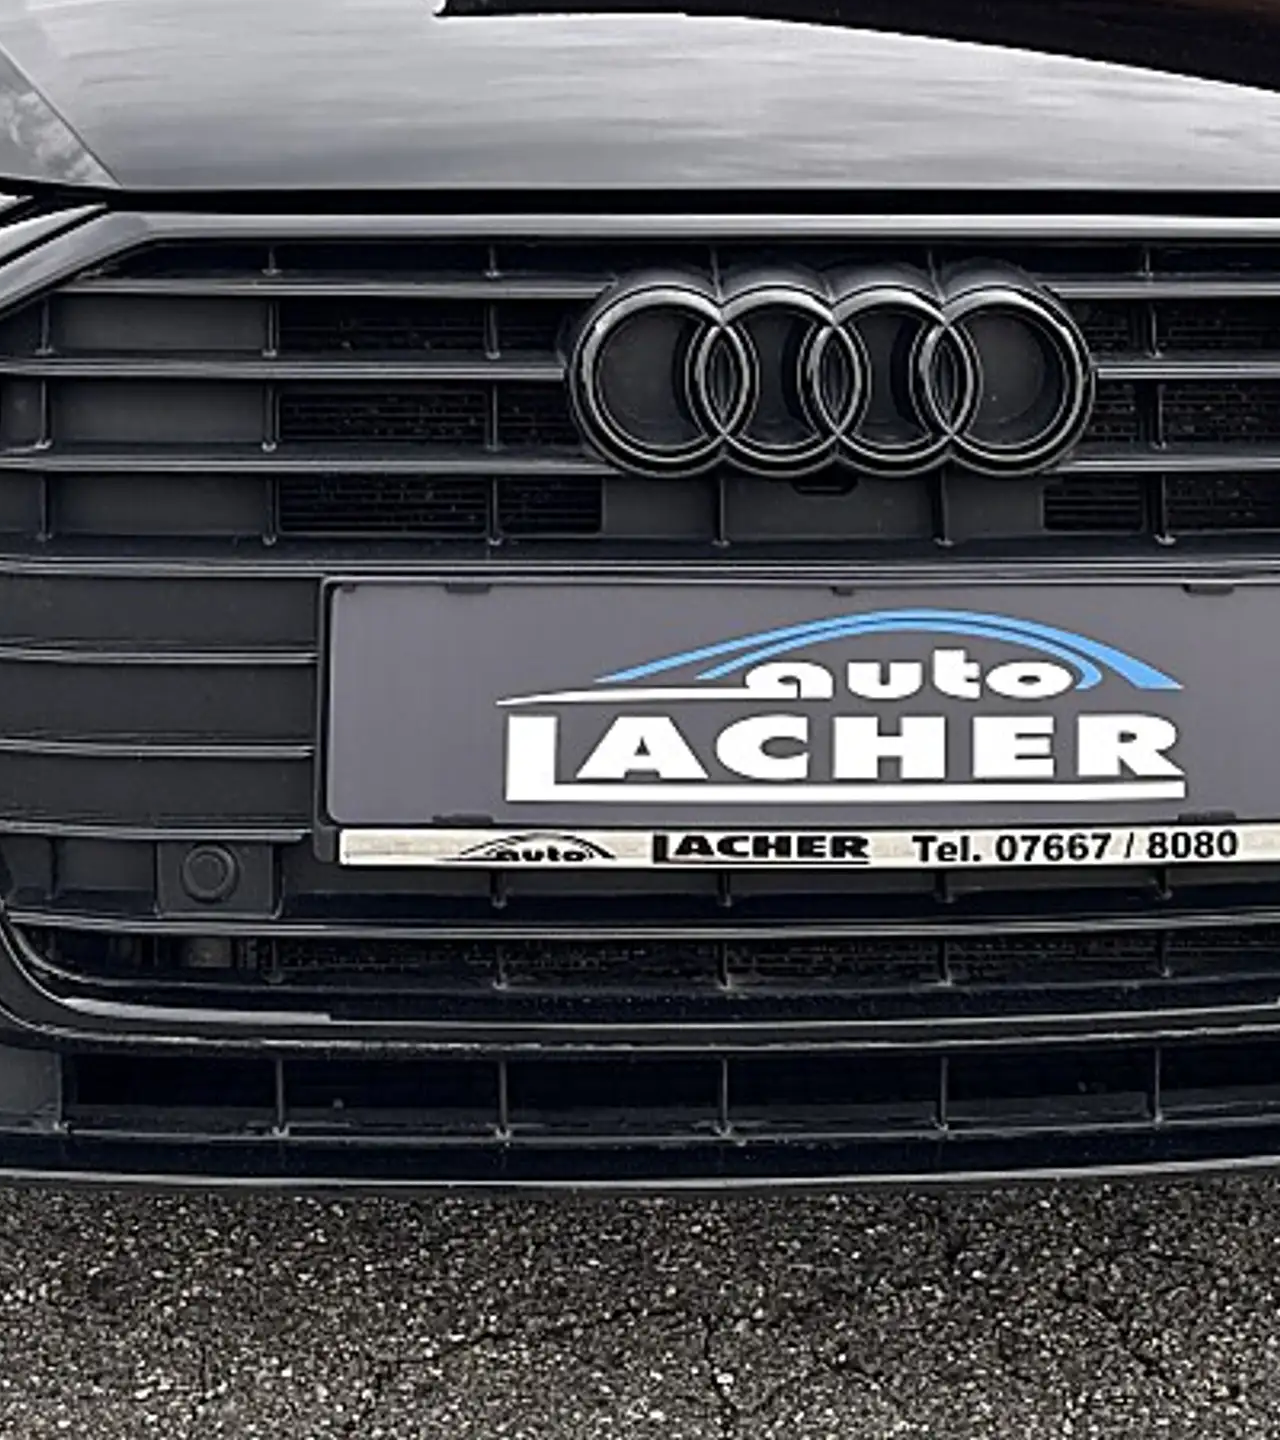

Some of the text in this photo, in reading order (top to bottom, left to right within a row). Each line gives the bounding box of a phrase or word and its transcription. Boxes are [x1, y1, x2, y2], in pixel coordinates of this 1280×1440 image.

[744, 648, 1075, 701] auto
[505, 714, 1187, 802] LACHER
[494, 844, 588, 863] auto
[651, 832, 871, 864] LACHER
[912, 834, 982, 862] Tel.
[994, 833, 1112, 862] 07667
[1147, 830, 1240, 859] 8080
